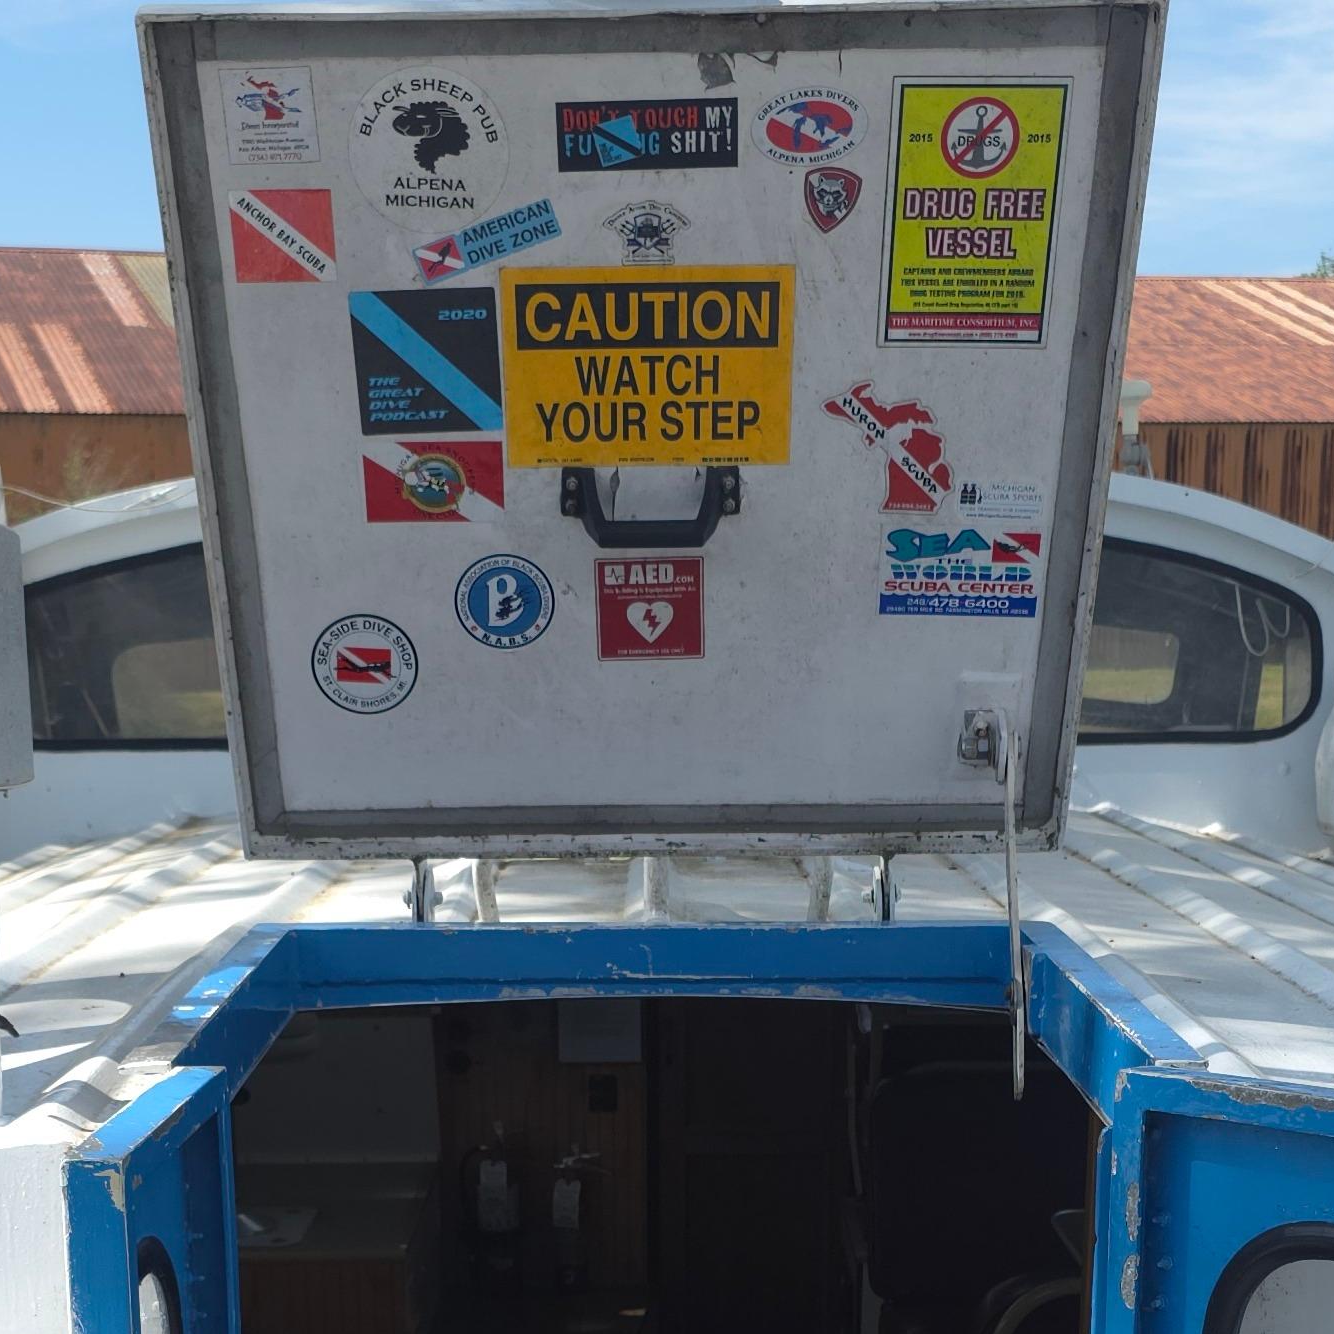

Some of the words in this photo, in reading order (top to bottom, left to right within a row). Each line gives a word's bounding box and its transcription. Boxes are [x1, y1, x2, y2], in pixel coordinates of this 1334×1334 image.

[359, 82, 408, 137] BLACK
[410, 78, 474, 103] SHEEP
[472, 104, 499, 144] PUB
[630, 105, 699, 130] TOUCH
[705, 105, 733, 128] MY
[757, 95, 786, 121] GREAT
[789, 89, 823, 101] LAKES
[826, 90, 860, 112] DIVERS
[670, 128, 733, 153] SHIT!
[909, 133, 933, 143] 2015
[958, 135, 1001, 147] DRUGS
[1027, 134, 1052, 143] 2015
[767, 148, 805, 164] ALPENA
[809, 140, 855, 164] MICHIGAN
[393, 177, 466, 191] ALPENA
[385, 194, 475, 209] MICHIGAN
[903, 188, 977, 220] DRUG
[983, 189, 1047, 221] FREE
[463, 200, 551, 246] AMERICAN
[236, 197, 277, 233] ANCHOR
[276, 229, 297, 248] BAY
[296, 245, 326, 275] SCUBA
[466, 239, 507, 264] DIVE
[509, 219, 558, 249] ZONE
[925, 226, 1017, 259] VESSEL
[438, 309, 487, 321] 2020
[524, 290, 771, 343] CAUTION
[892, 318, 909, 326] THE
[910, 318, 954, 326] MARITIME
[368, 377, 401, 387] THE
[574, 354, 720, 397] WATCH
[368, 387, 425, 399] GREAT
[368, 399, 412, 410] DIVE
[369, 410, 449, 422] PODCAST
[535, 401, 647, 443] YOUR
[660, 400, 761, 441] STEP
[842, 397, 885, 439] HURON
[901, 457, 937, 494] SCUBA
[885, 528, 991, 562] SEA
[890, 564, 1032, 582] WORLD
[884, 581, 952, 593] SCUBA
[957, 583, 1034, 595] CENTER
[317, 620, 359, 666] SEA-SIDE
[363, 620, 393, 639] DIVE
[392, 635, 413, 670] SHOP
